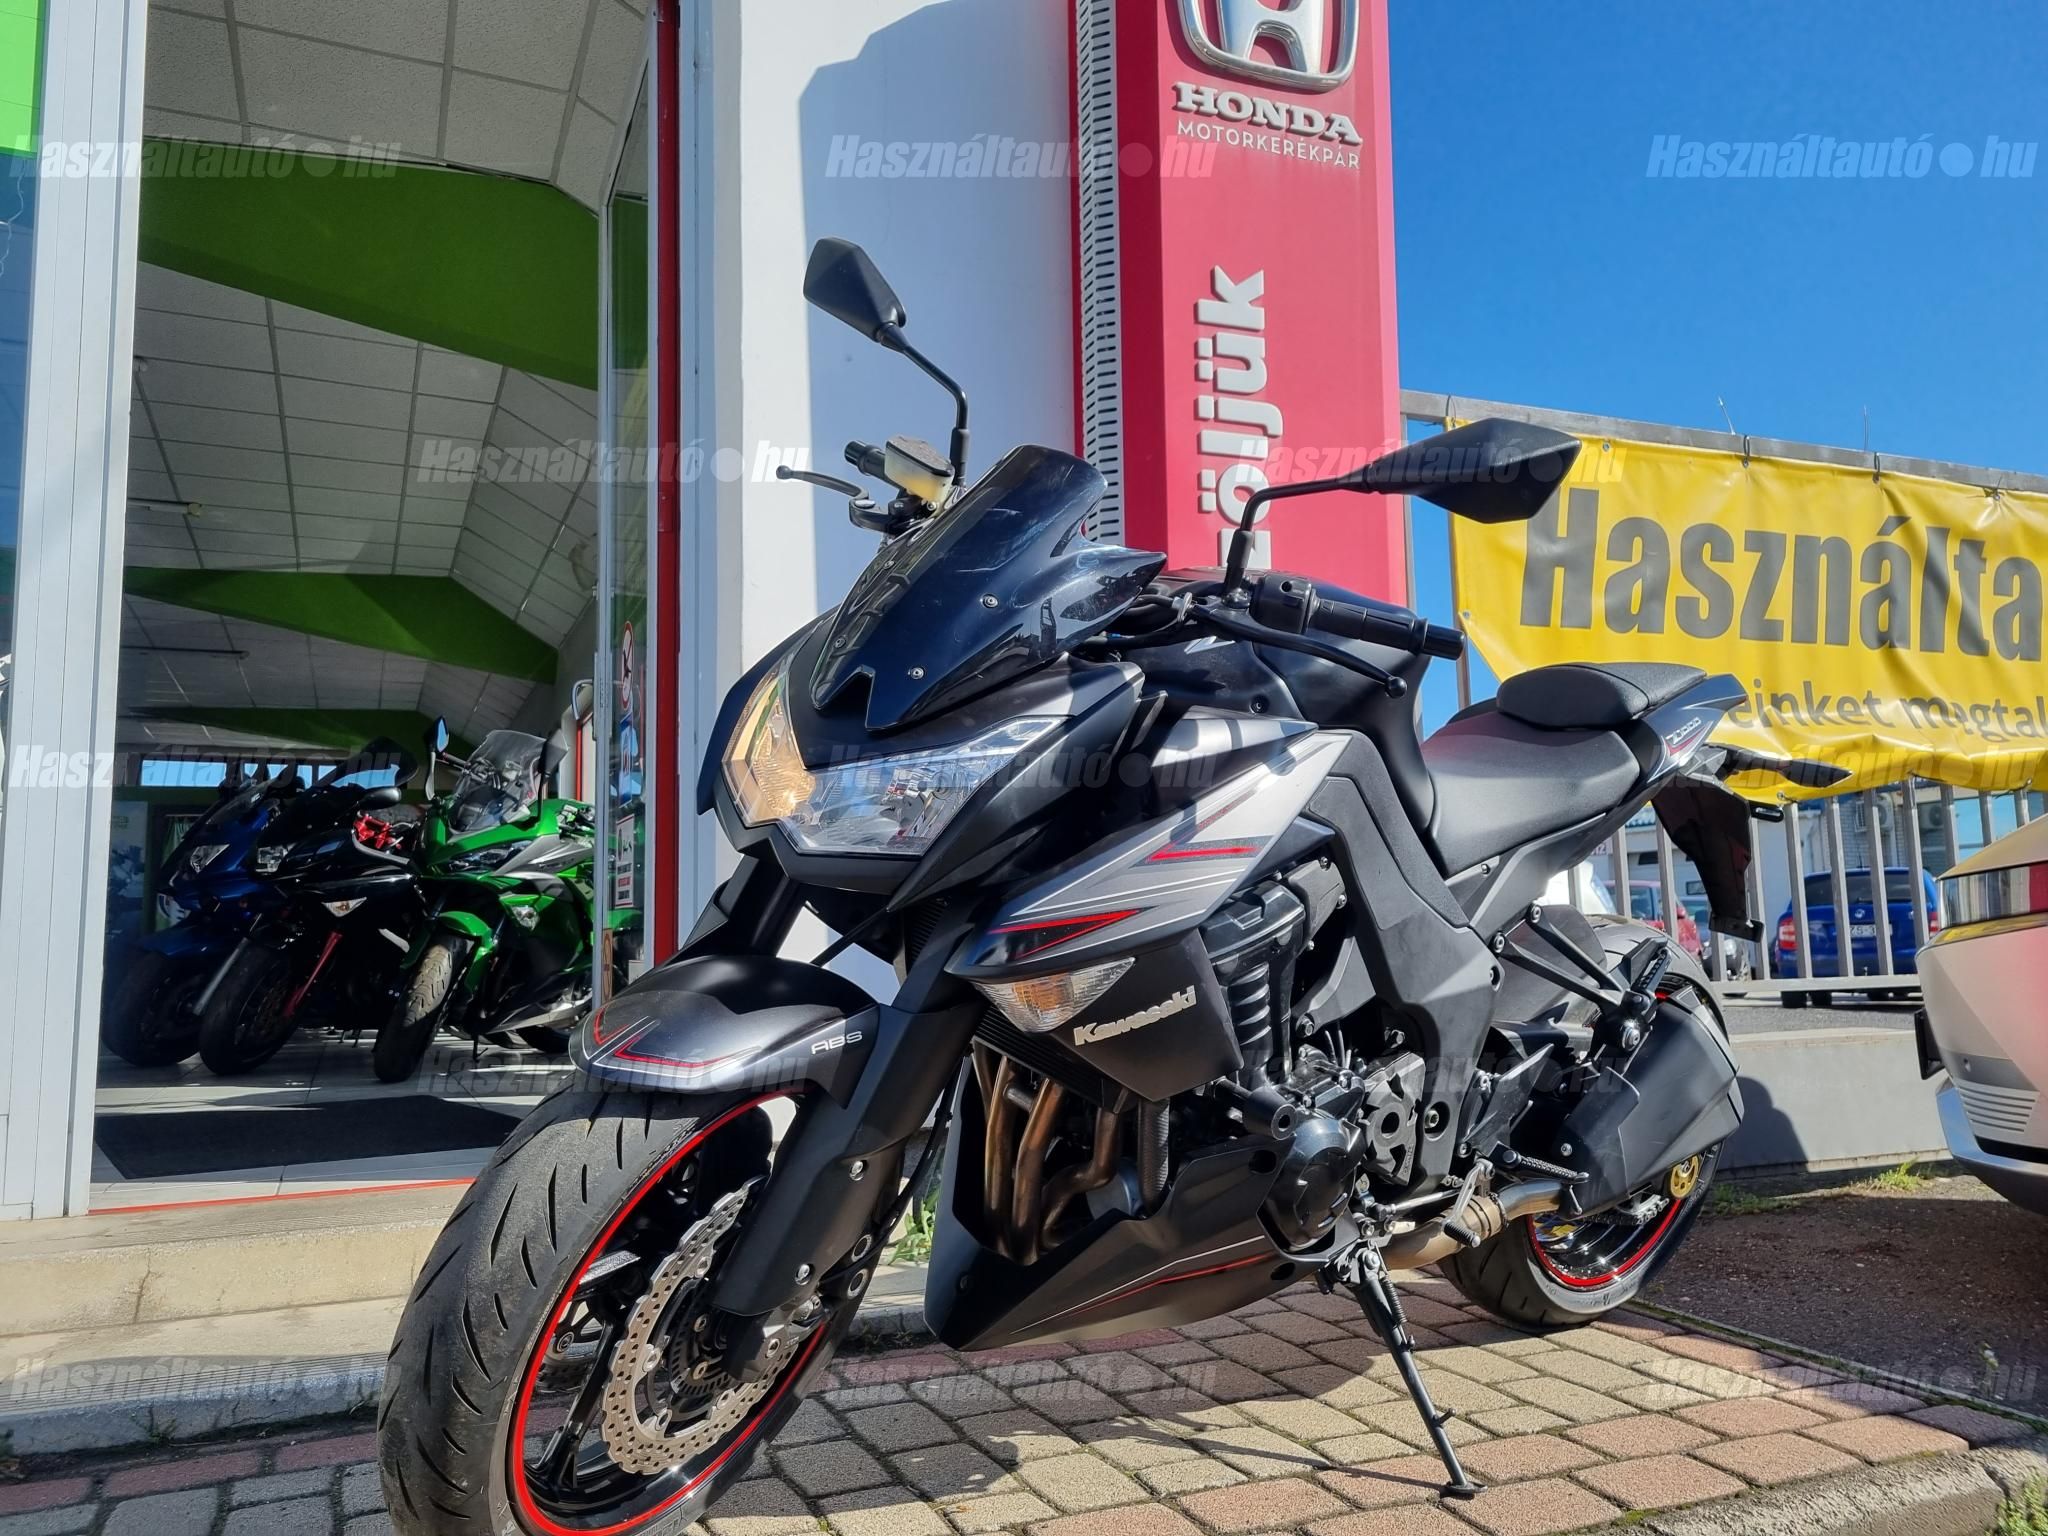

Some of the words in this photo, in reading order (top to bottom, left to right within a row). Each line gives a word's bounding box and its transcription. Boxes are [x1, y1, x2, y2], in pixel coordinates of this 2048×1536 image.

[1175, 81, 1364, 145] HONDA
[1177, 120, 1360, 169] MOTORKERÉKPÁR
[1520, 486, 2044, 663] Használta
[811, 1030, 863, 1055] ABS
[1073, 984, 1198, 1046] Kawasaki
